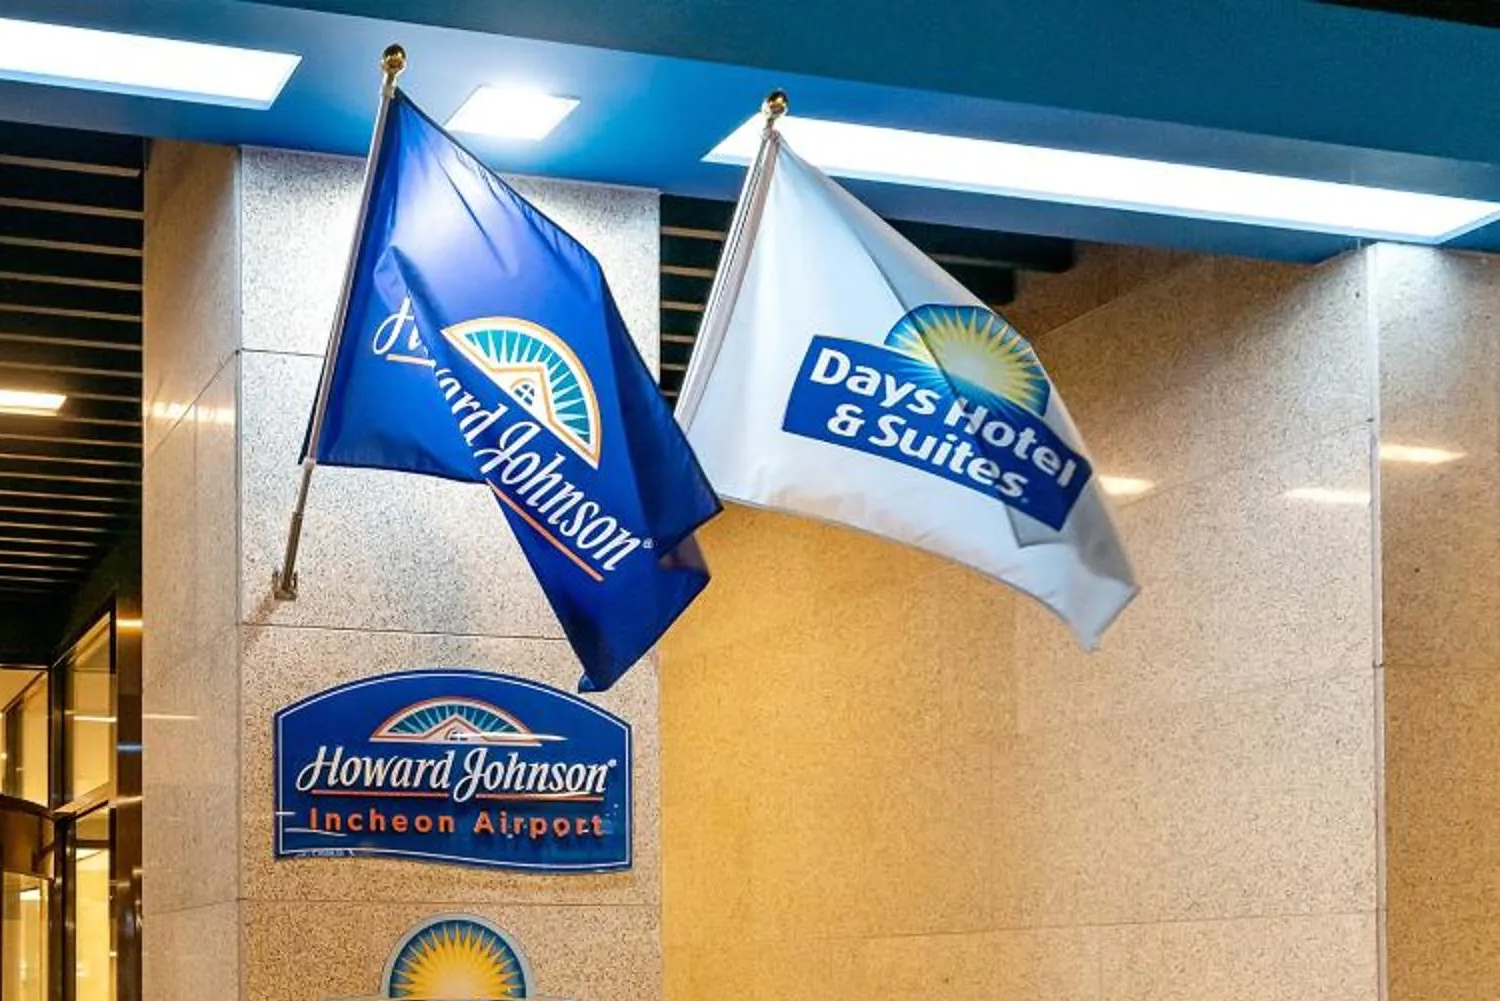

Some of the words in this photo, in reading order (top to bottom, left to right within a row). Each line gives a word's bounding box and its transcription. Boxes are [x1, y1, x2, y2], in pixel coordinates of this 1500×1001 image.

[810, 348, 940, 415] Days
[943, 397, 1077, 487] Hotel
[827, 403, 865, 437] &
[296, 745, 455, 791] Howard
[310, 807, 455, 833] Incheon
[473, 810, 603, 839] Airport
